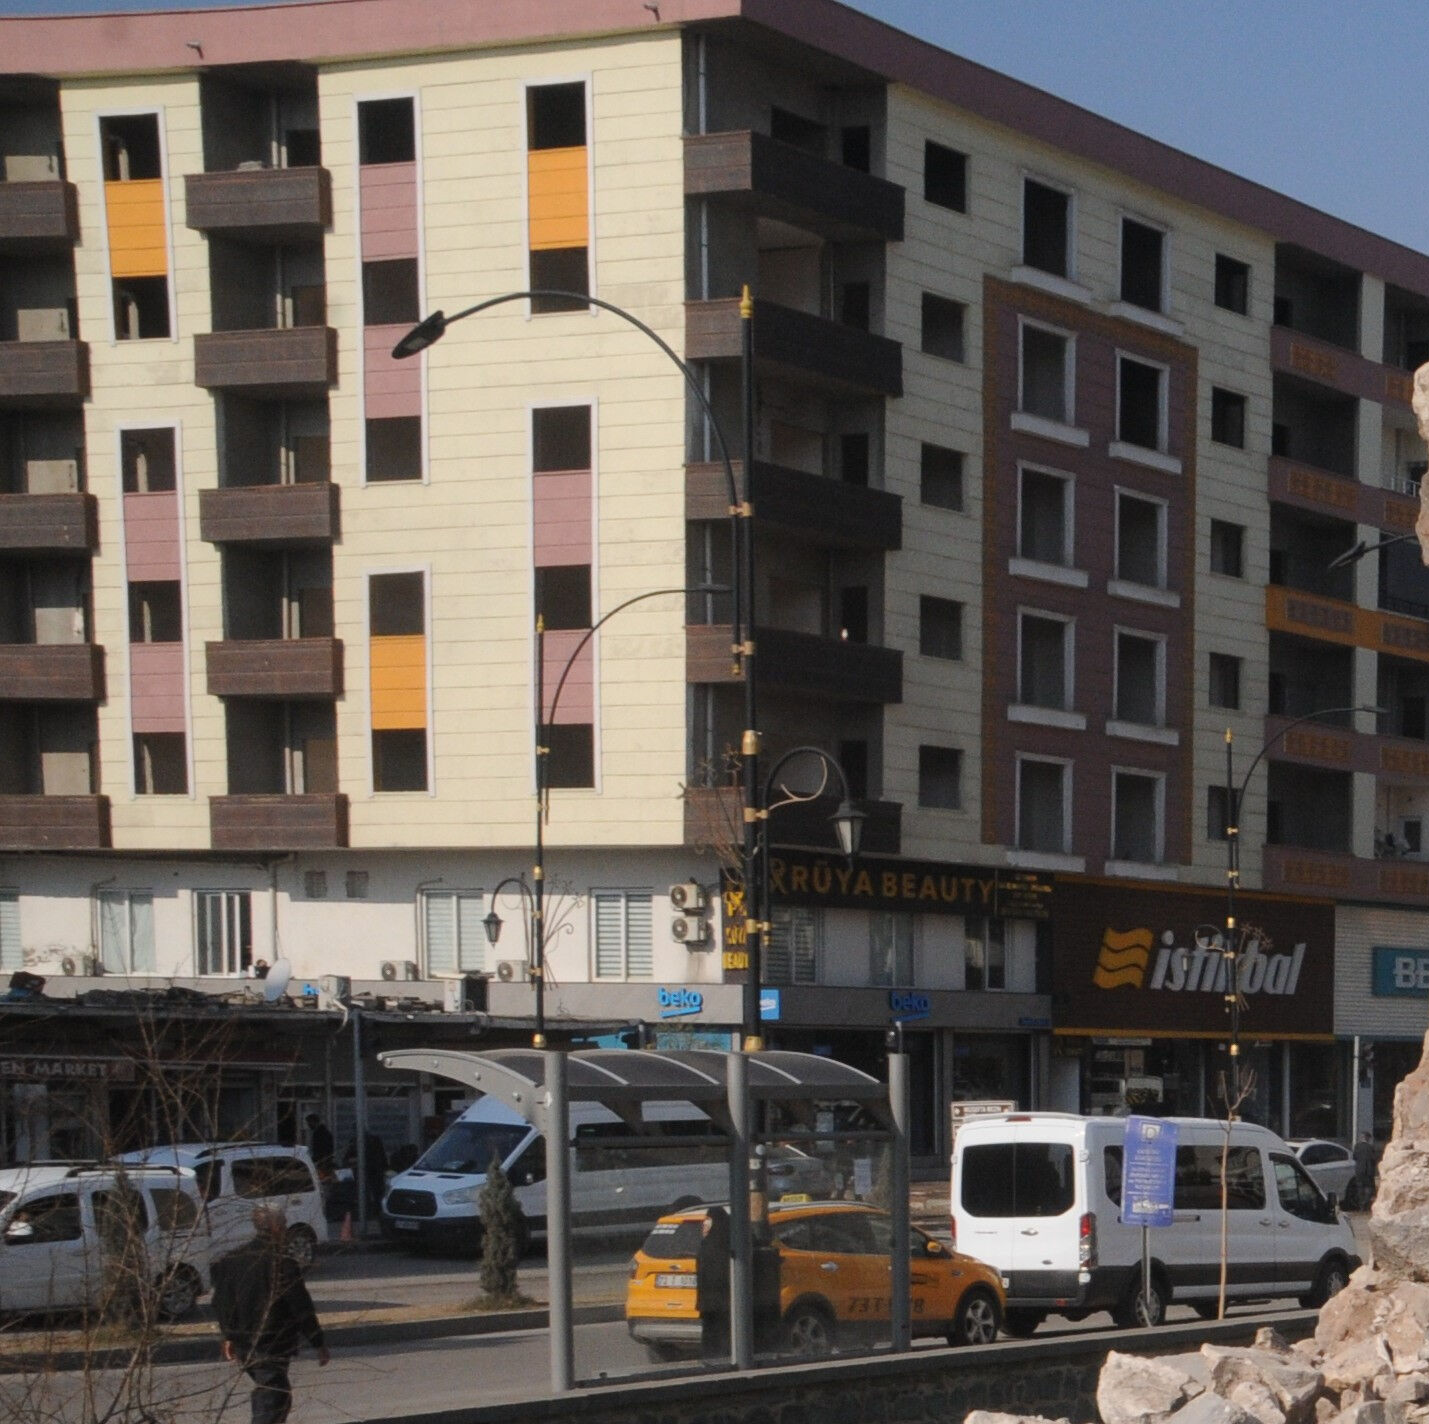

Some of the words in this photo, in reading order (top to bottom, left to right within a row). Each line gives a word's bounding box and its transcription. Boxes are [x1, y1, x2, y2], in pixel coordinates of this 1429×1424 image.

[791, 861, 873, 896] RÜYA
[881, 871, 995, 904] BEAUTY
[657, 986, 703, 1007] beko
[890, 991, 931, 1011] beko
[33, 1061, 107, 1077] MARKET
